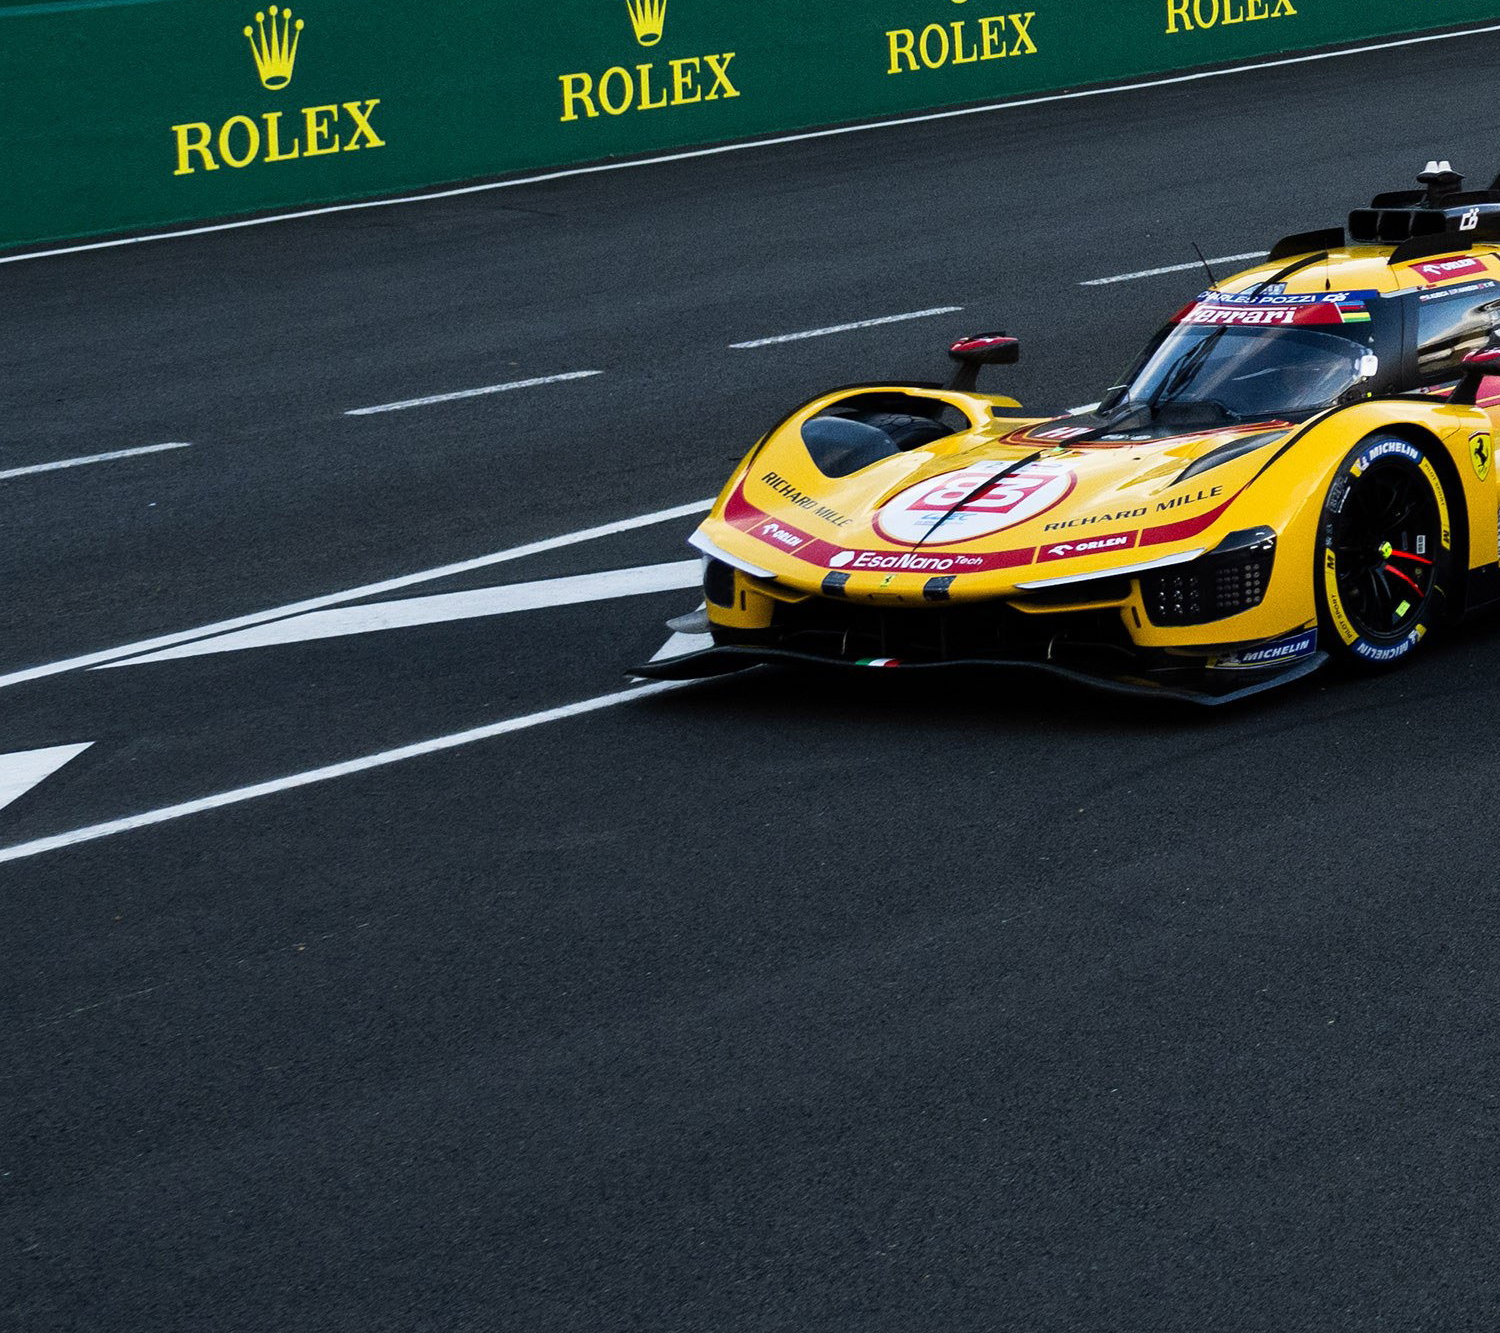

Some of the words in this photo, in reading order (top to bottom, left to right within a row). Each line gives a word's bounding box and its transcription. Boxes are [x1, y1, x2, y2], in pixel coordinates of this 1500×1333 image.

[886, 13, 1036, 74] ROLEX
[559, 52, 741, 122] ROLEX
[172, 98, 386, 176] ROLEX
[1369, 441, 1420, 460] MICHELIN
[762, 472, 816, 514] RICHARD
[810, 503, 852, 528] MILLE
[1043, 506, 1149, 532] RICHARD
[1154, 485, 1224, 513] MILLE
[853, 551, 954, 571] EsaNano
[954, 554, 983, 566] Tech
[1076, 536, 1128, 551] ORLEN
[1243, 637, 1311, 663] MICHELIN
